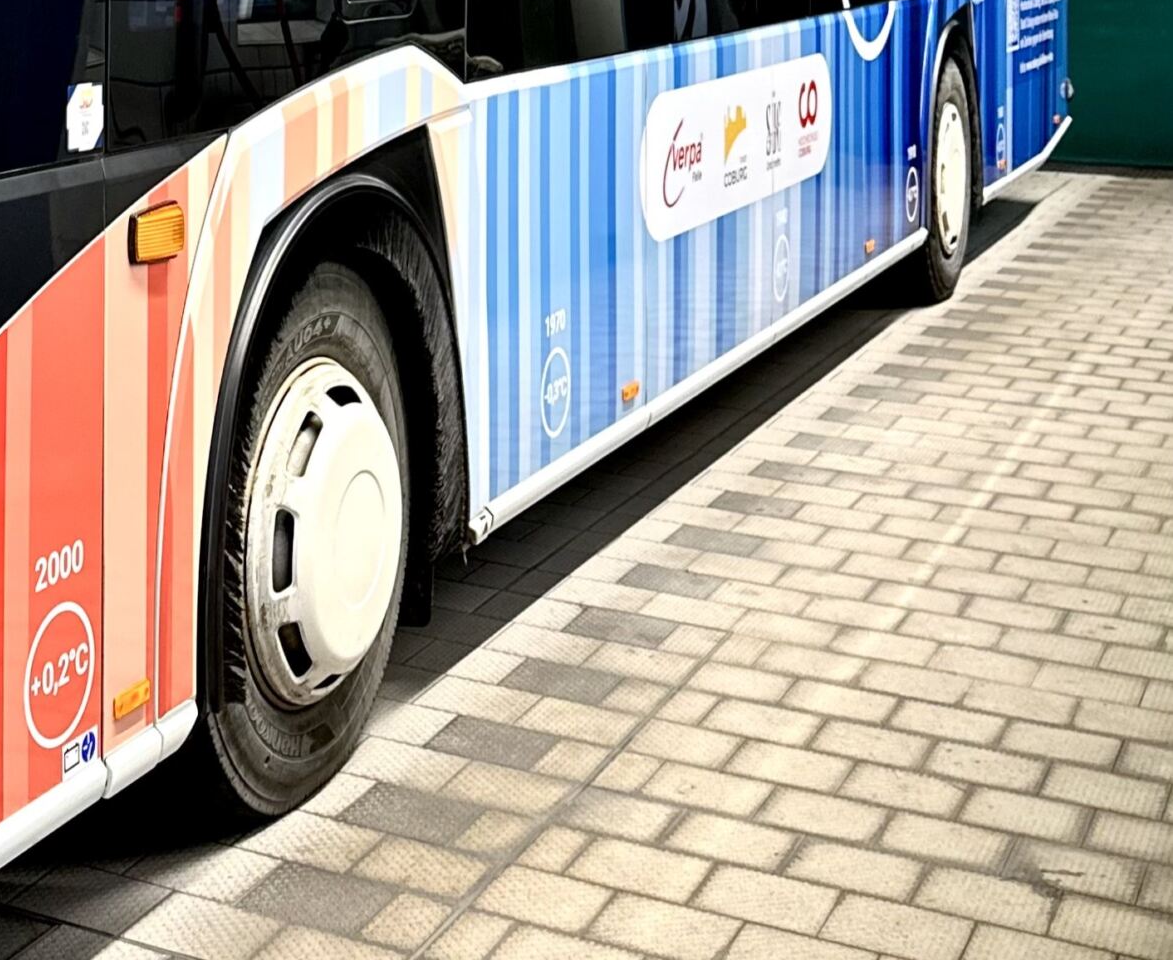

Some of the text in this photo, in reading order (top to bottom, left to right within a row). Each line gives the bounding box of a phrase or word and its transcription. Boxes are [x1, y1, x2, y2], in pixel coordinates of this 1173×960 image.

[545, 308, 566, 338] 1970
[34, 539, 84, 593] 2000
[30, 642, 89, 696] +0,2°C
